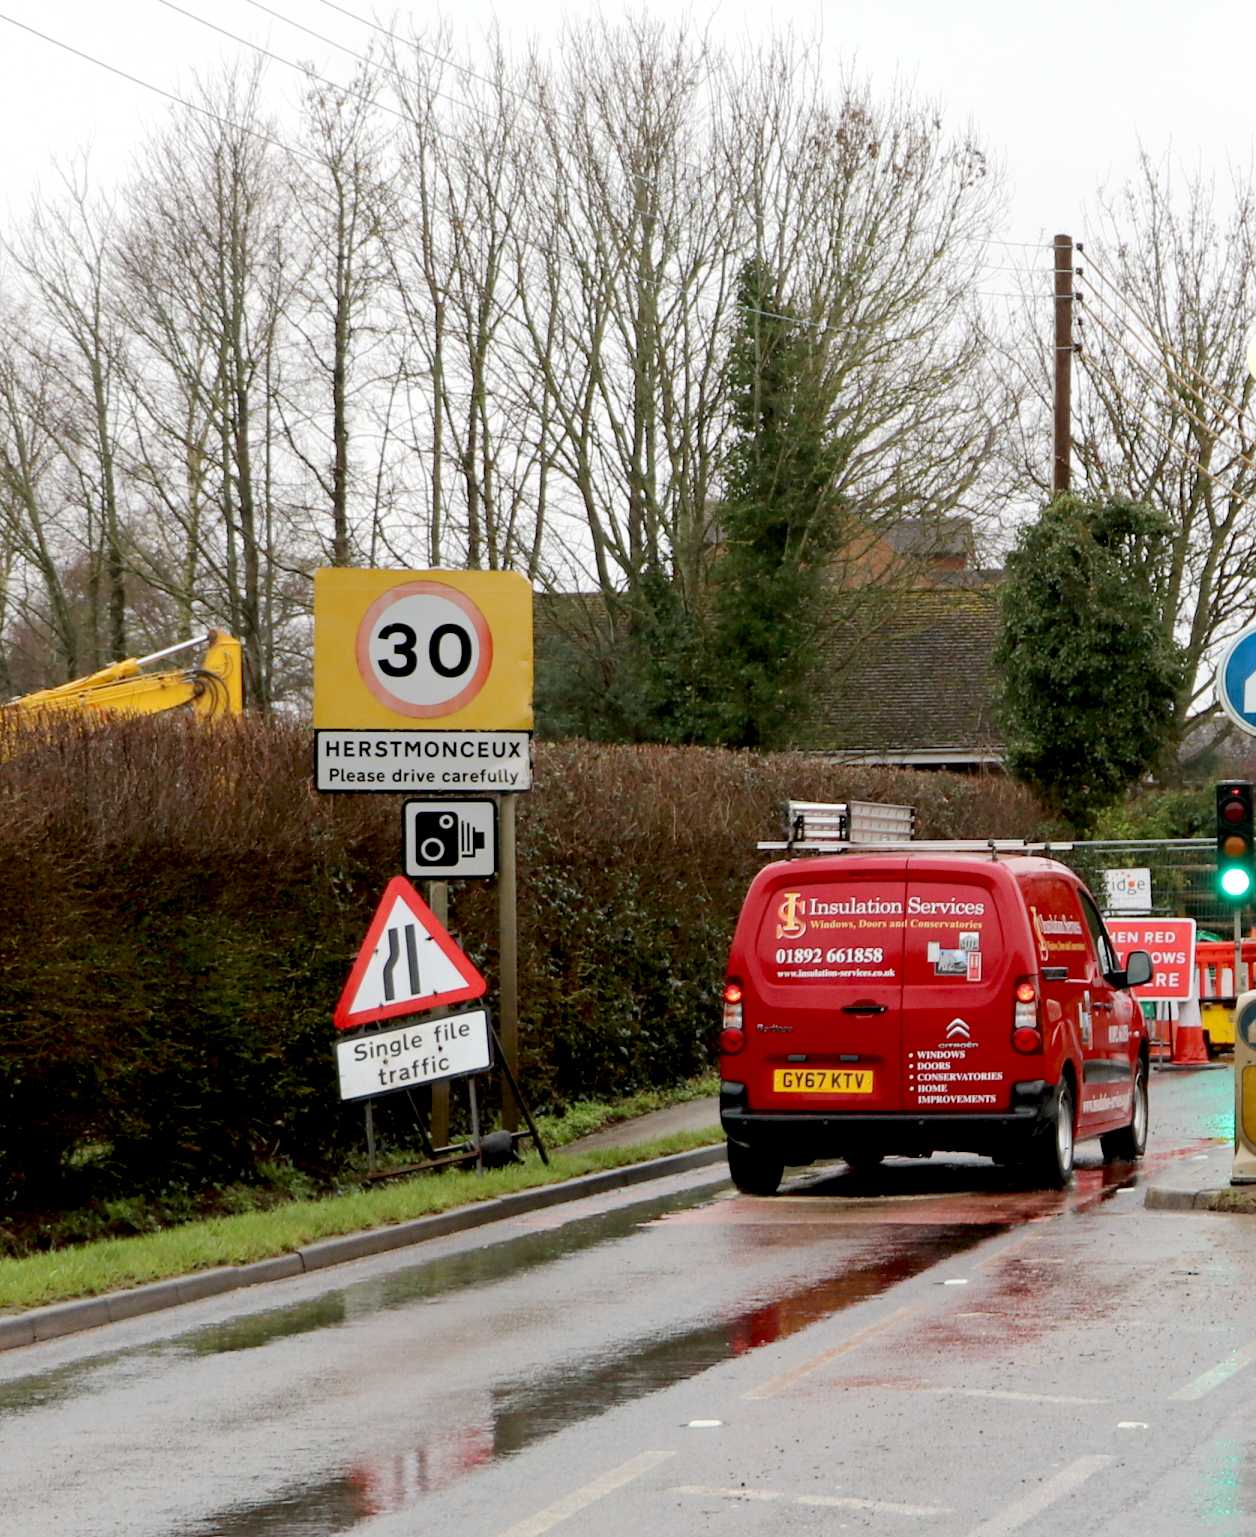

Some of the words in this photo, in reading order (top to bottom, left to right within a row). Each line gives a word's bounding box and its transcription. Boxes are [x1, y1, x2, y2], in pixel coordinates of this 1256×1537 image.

[377, 622, 473, 678] 30
[325, 740, 521, 758] HERSTMONCEUX
[328, 768, 385, 783] Please
[392, 768, 436, 784] drive
[442, 768, 519, 785] carefully
[808, 897, 904, 916] Insulation
[907, 896, 985, 915] Services
[810, 919, 857, 930] Windows,
[859, 919, 888, 928] Doors
[889, 918, 908, 928] and
[910, 919, 983, 929] Conservatories
[1144, 931, 1176, 944] RED
[776, 948, 823, 964] 01892
[826, 947, 884, 963] 661858
[354, 1034, 422, 1062] Single
[434, 1023, 470, 1043] file
[917, 1050, 966, 1059] WINDOWS
[378, 1056, 449, 1085] traffic
[917, 1062, 951, 1071] DOORS
[783, 1072, 826, 1088] GY67
[831, 1073, 865, 1089] KTV
[917, 1072, 1003, 1082] CONSERVATORIES
[918, 1084, 948, 1093] HOME
[918, 1094, 997, 1104] IMPROVEMENTS
